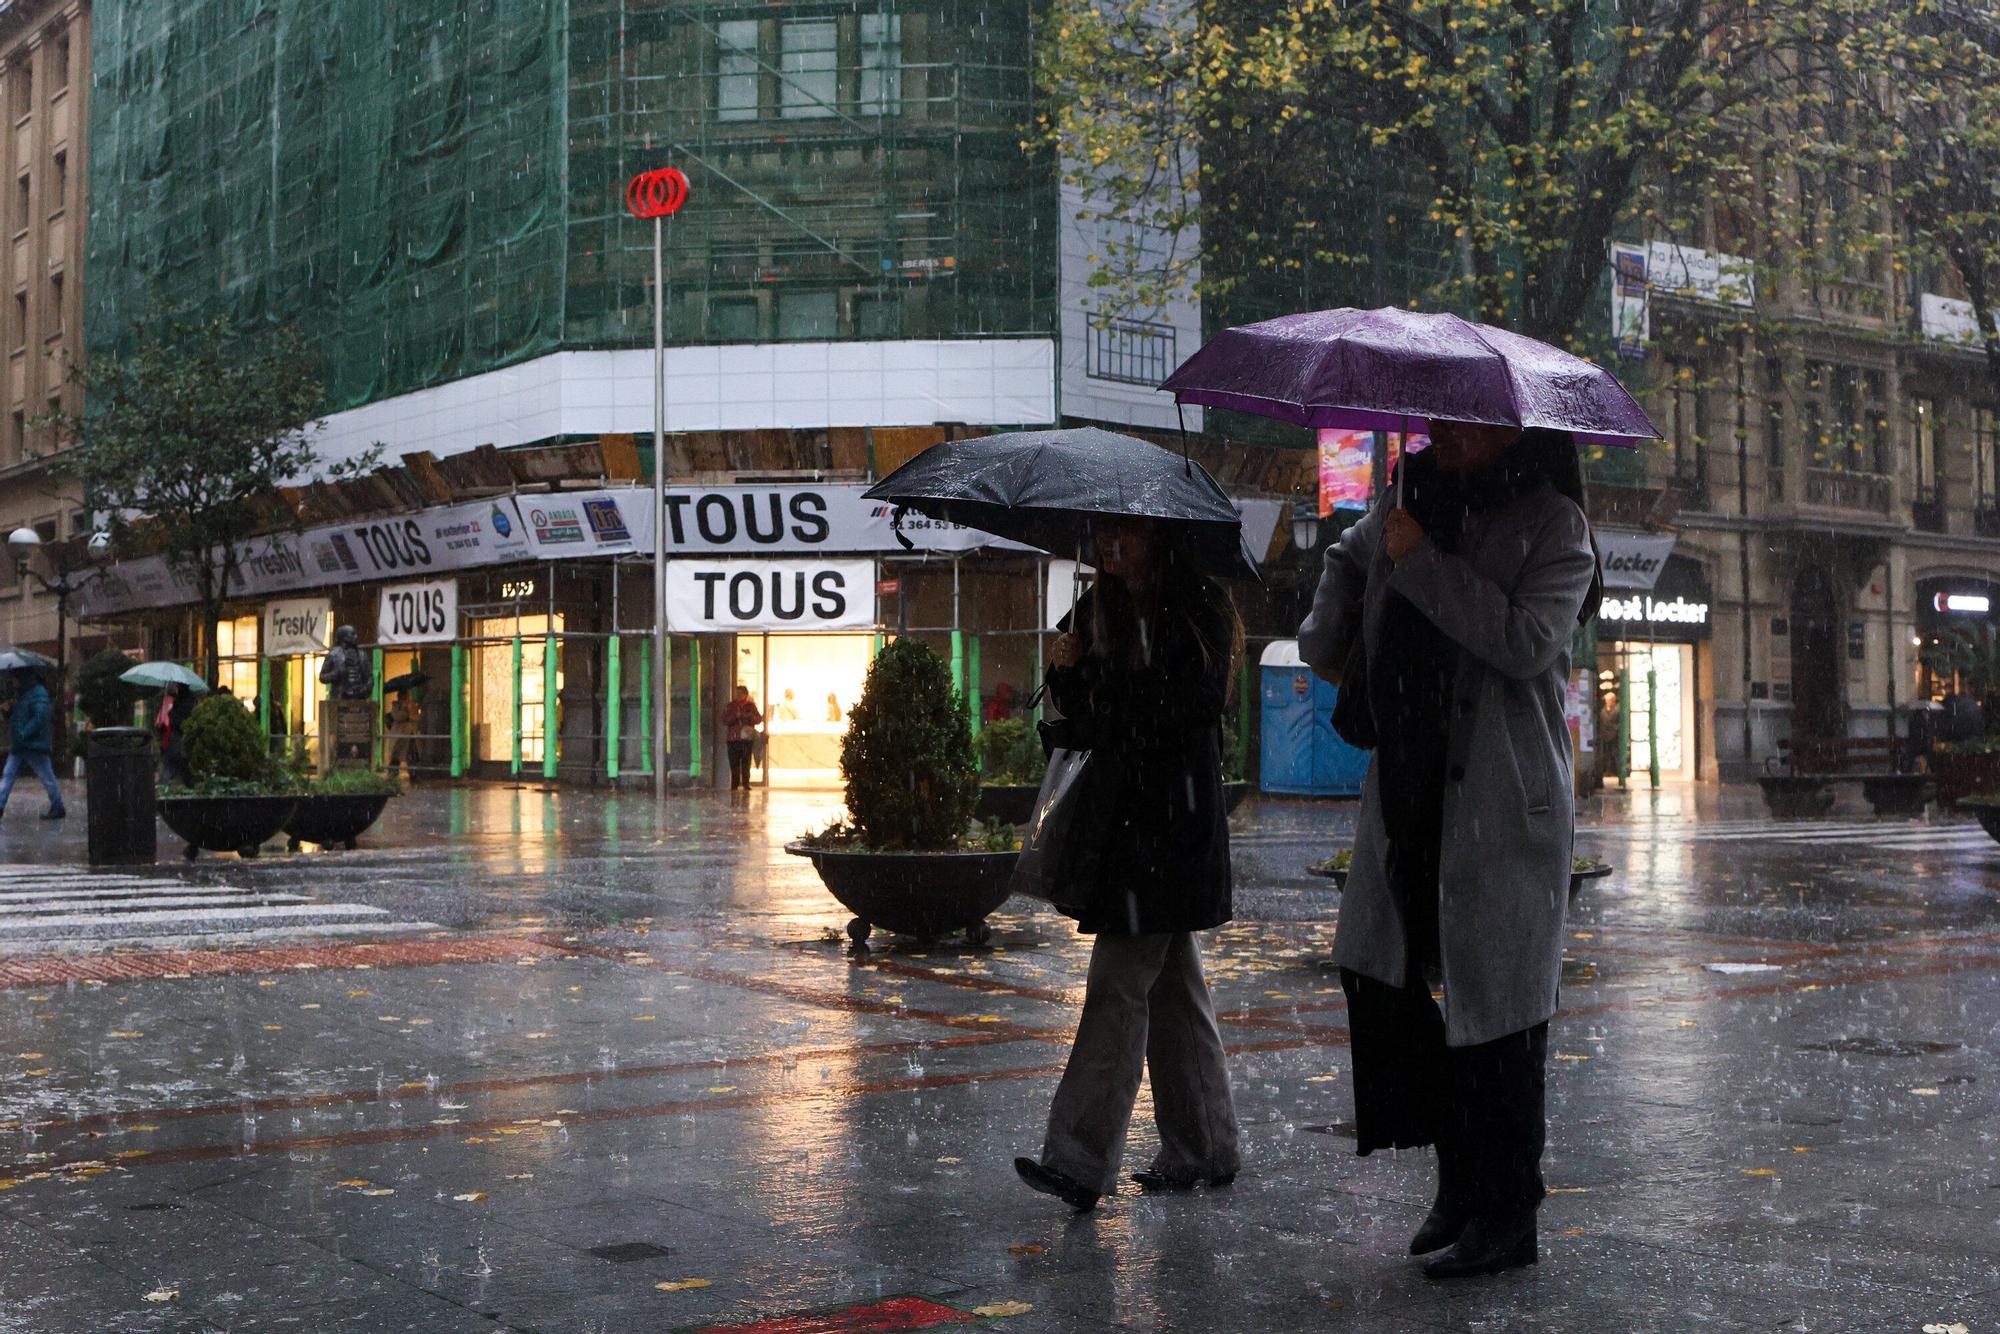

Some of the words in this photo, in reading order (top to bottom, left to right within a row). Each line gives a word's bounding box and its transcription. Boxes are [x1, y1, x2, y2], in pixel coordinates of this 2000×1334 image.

[664, 492, 830, 544] TOUS
[908, 521, 931, 530] 364
[354, 519, 432, 571] TOUS
[1605, 551, 1660, 572] Locker
[388, 588, 445, 635] TOUS
[694, 570, 846, 620] TOUS
[1646, 596, 1708, 623] Locker
